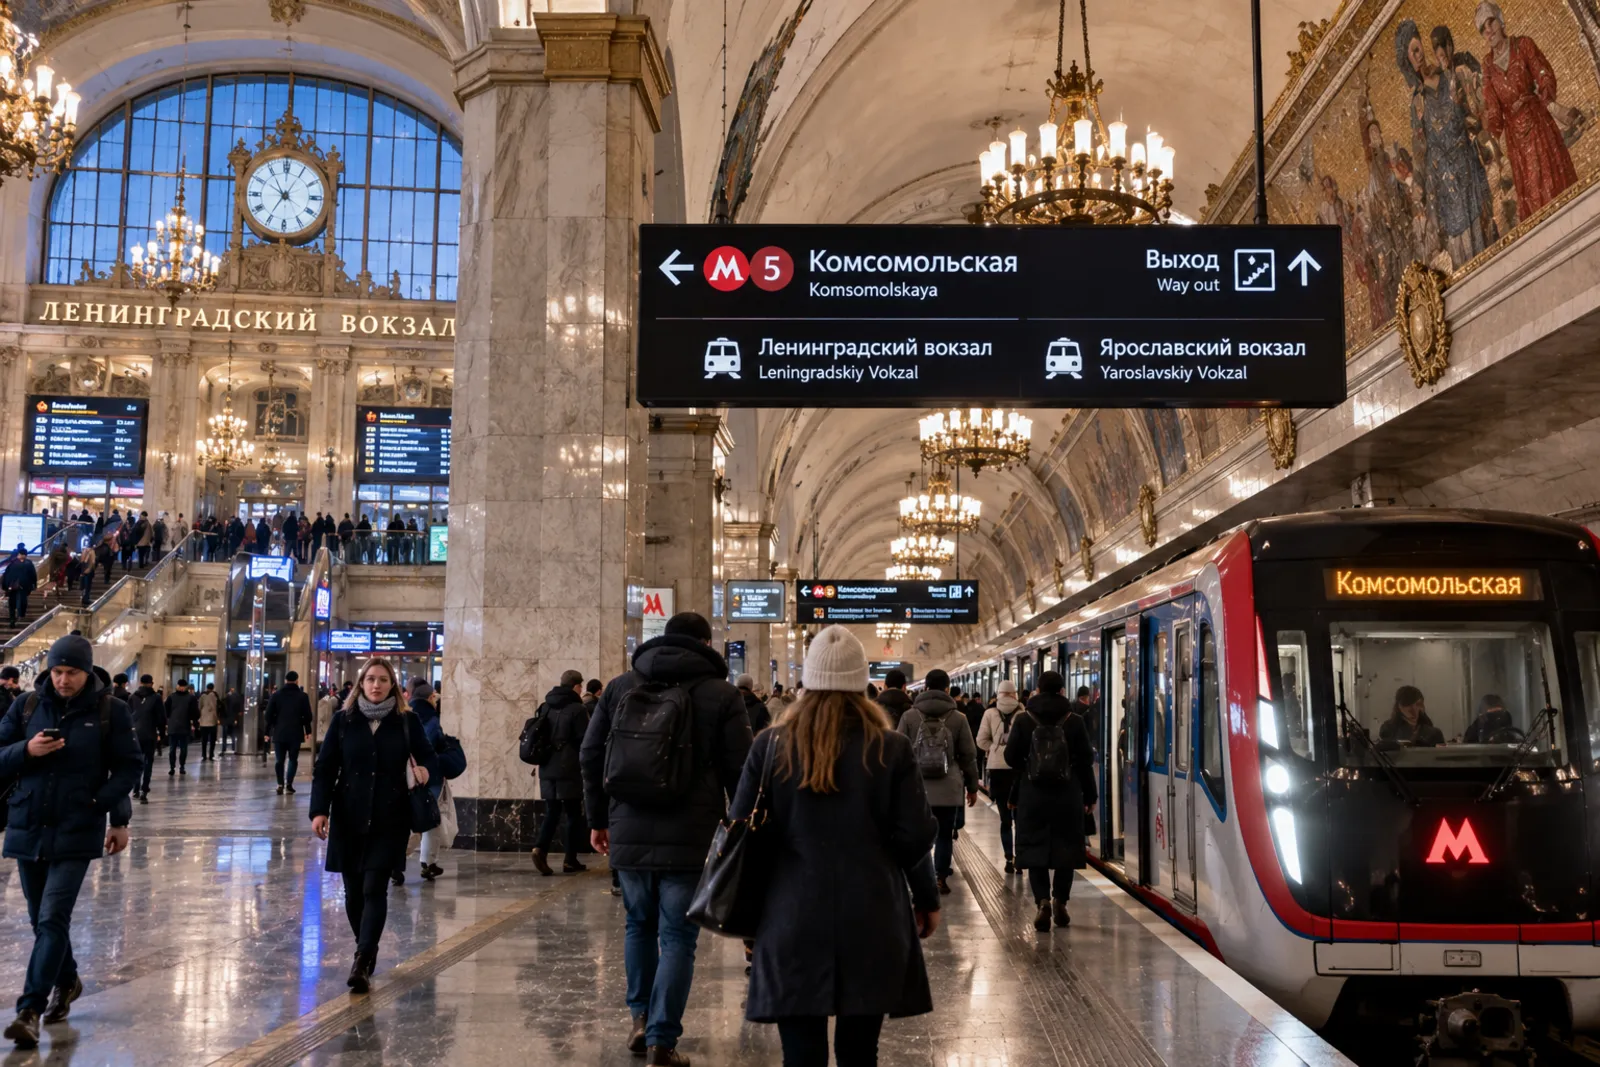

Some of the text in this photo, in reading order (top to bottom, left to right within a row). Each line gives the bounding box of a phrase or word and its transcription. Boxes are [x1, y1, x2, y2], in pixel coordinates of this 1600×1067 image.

[764, 256, 783, 282] 5
[808, 249, 1018, 274] Комсомольская
[1145, 249, 1220, 272] Выход
[808, 281, 939, 301] Komsomolskaya
[1156, 277, 1221, 296] Way out
[38, 301, 456, 337] ЛЕНИНГРАДСКИЙ ВОКЗАЛ
[757, 337, 993, 361] Ленинградский вокзал
[1100, 337, 1307, 361] Ярославский вокзал
[758, 364, 920, 384] Leningradskiy Vokzal
[1100, 364, 1248, 384] Yaroslavskiy Vokzal
[1336, 570, 1523, 596] Комсомольская
[1425, 817, 1491, 865] М
